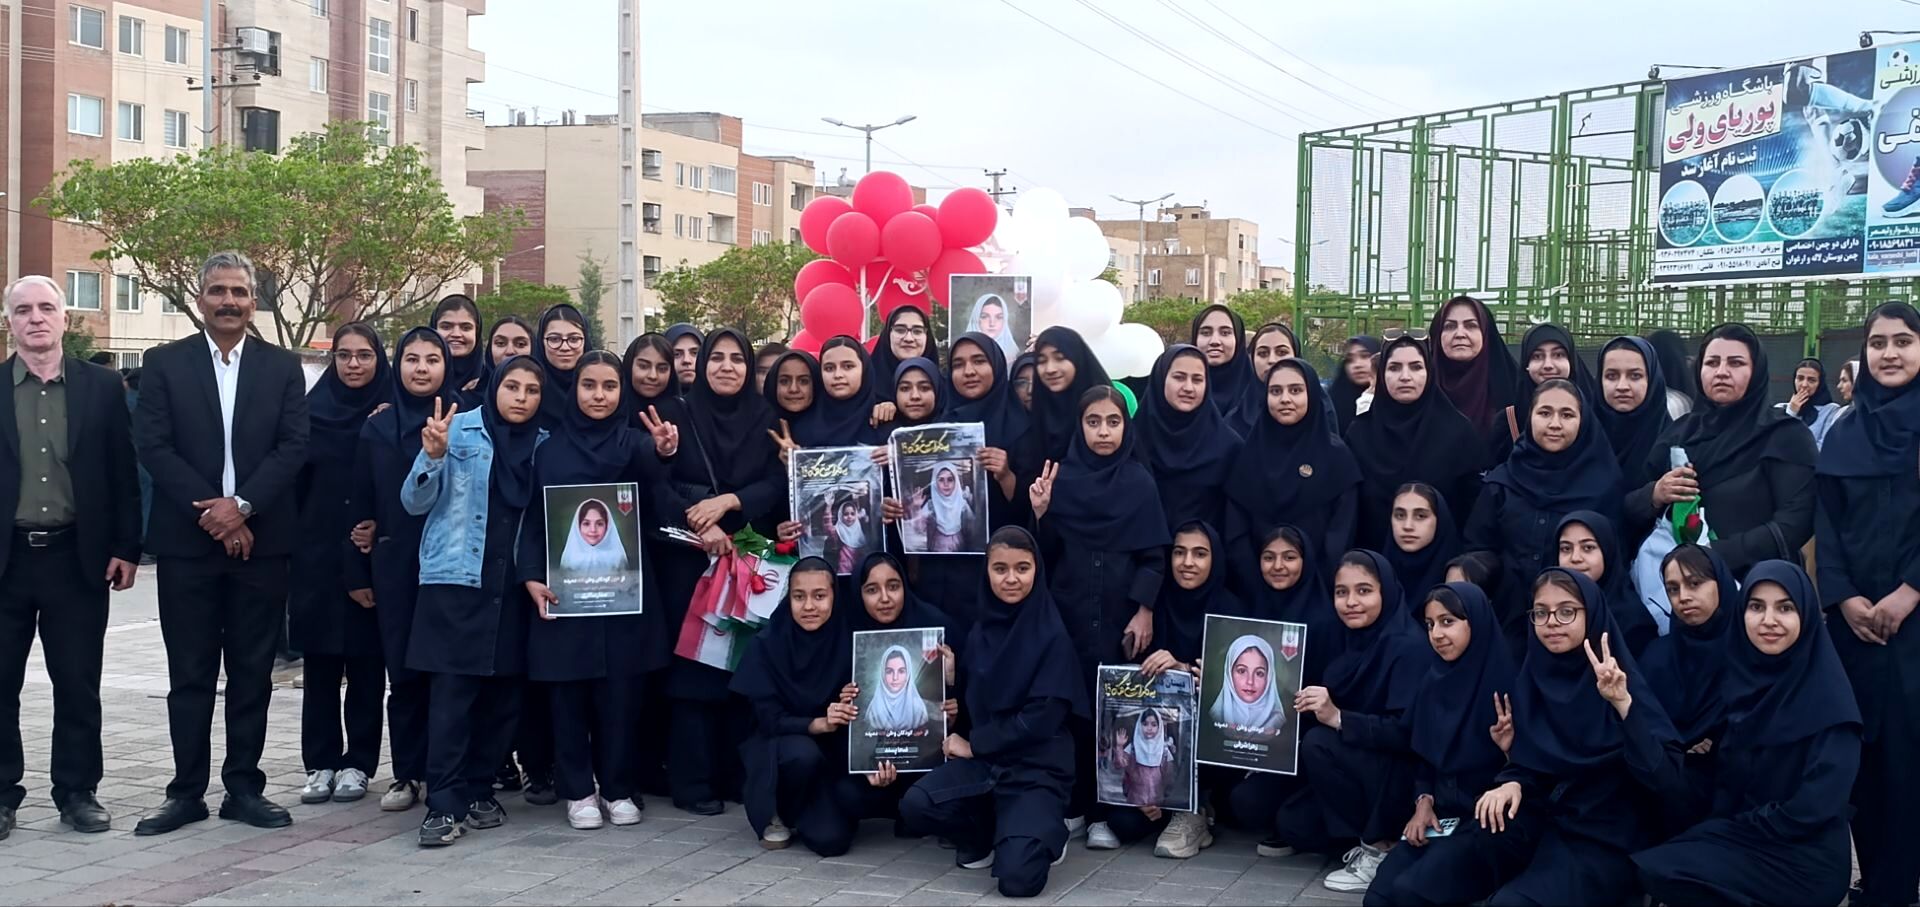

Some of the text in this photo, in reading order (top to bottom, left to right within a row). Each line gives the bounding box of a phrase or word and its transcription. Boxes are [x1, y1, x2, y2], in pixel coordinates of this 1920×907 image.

[1670, 75, 1773, 115] باشگاه ورزشی
[1667, 101, 1775, 152] پوریای ولی
[1697, 152, 1720, 178] آغاز
[1721, 152, 1737, 172] نام
[1737, 145, 1757, 165] ثبت
[1785, 238, 1860, 253] دارای دو چمن اختصاصی
[1785, 254, 1807, 266] ارغوان
[1822, 252, 1844, 264] بوستان
[1843, 252, 1859, 262] چمن
